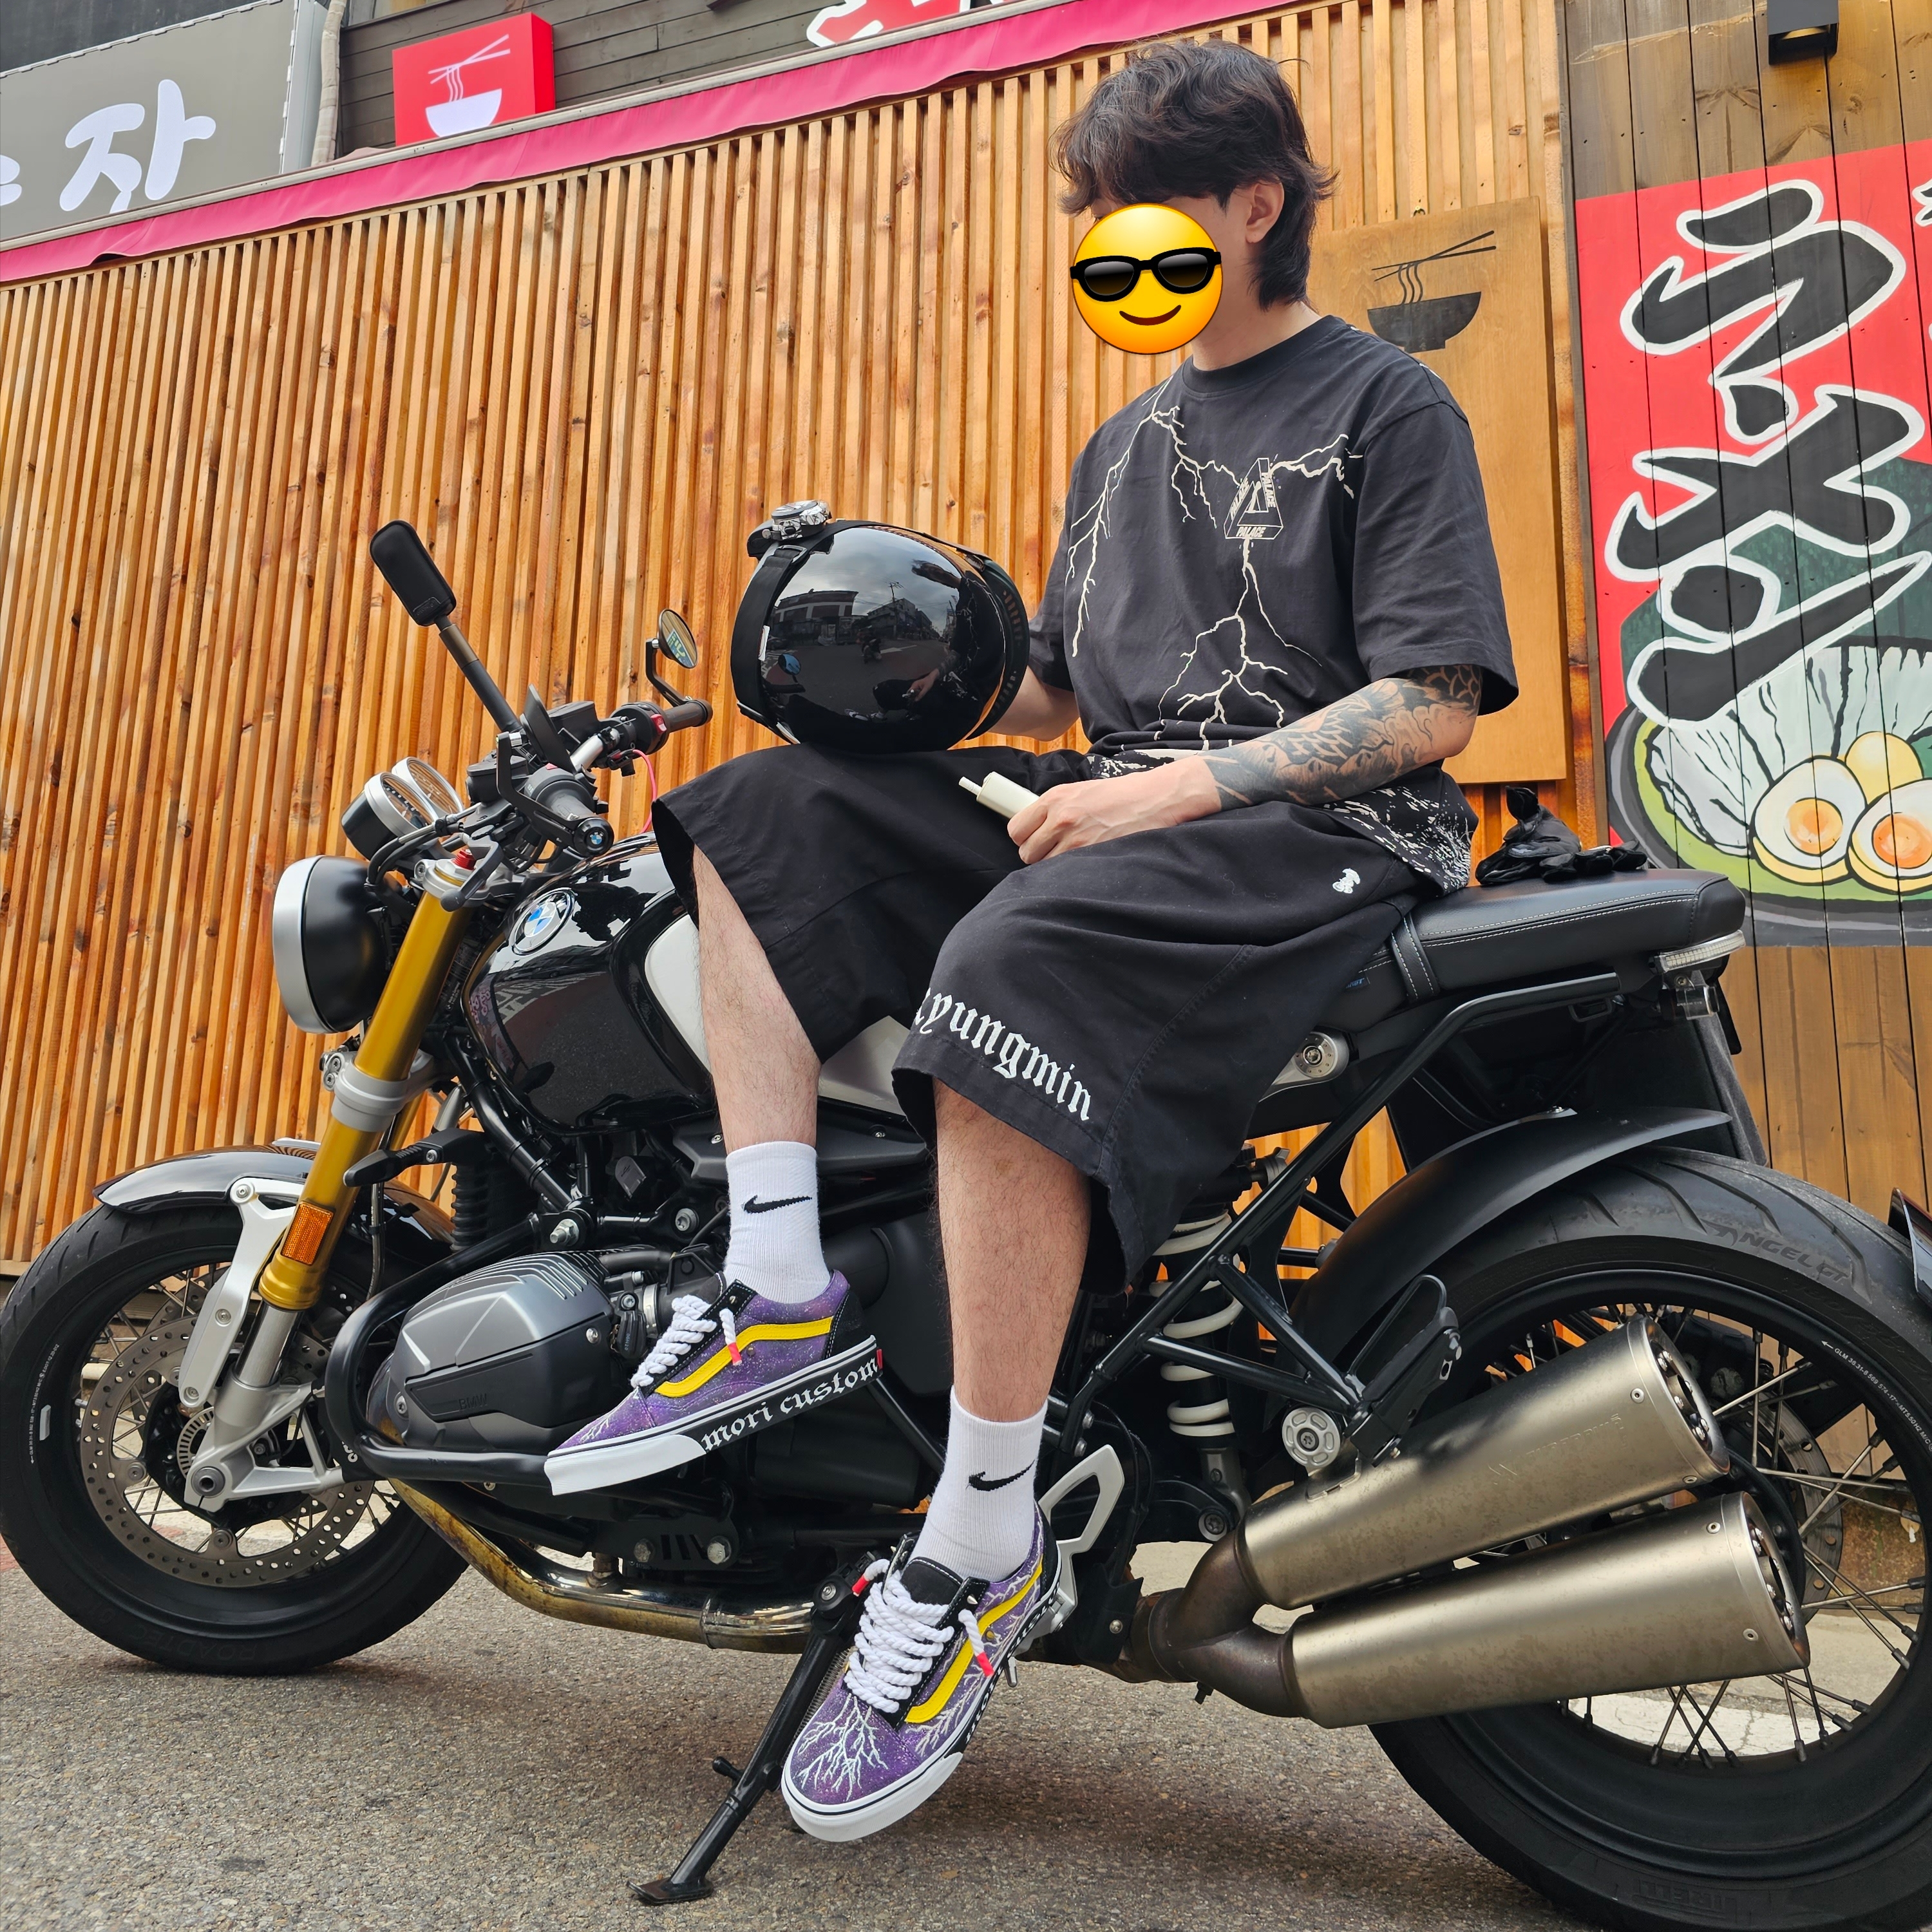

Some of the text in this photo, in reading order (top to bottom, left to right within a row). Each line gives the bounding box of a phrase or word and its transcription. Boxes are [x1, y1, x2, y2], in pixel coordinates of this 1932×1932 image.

[1235, 526, 1266, 538] PALACE
[1834, 1348, 1848, 1359] GLM
[459, 1393, 488, 1410] BMW
[701, 1357, 878, 1452] mori custom
